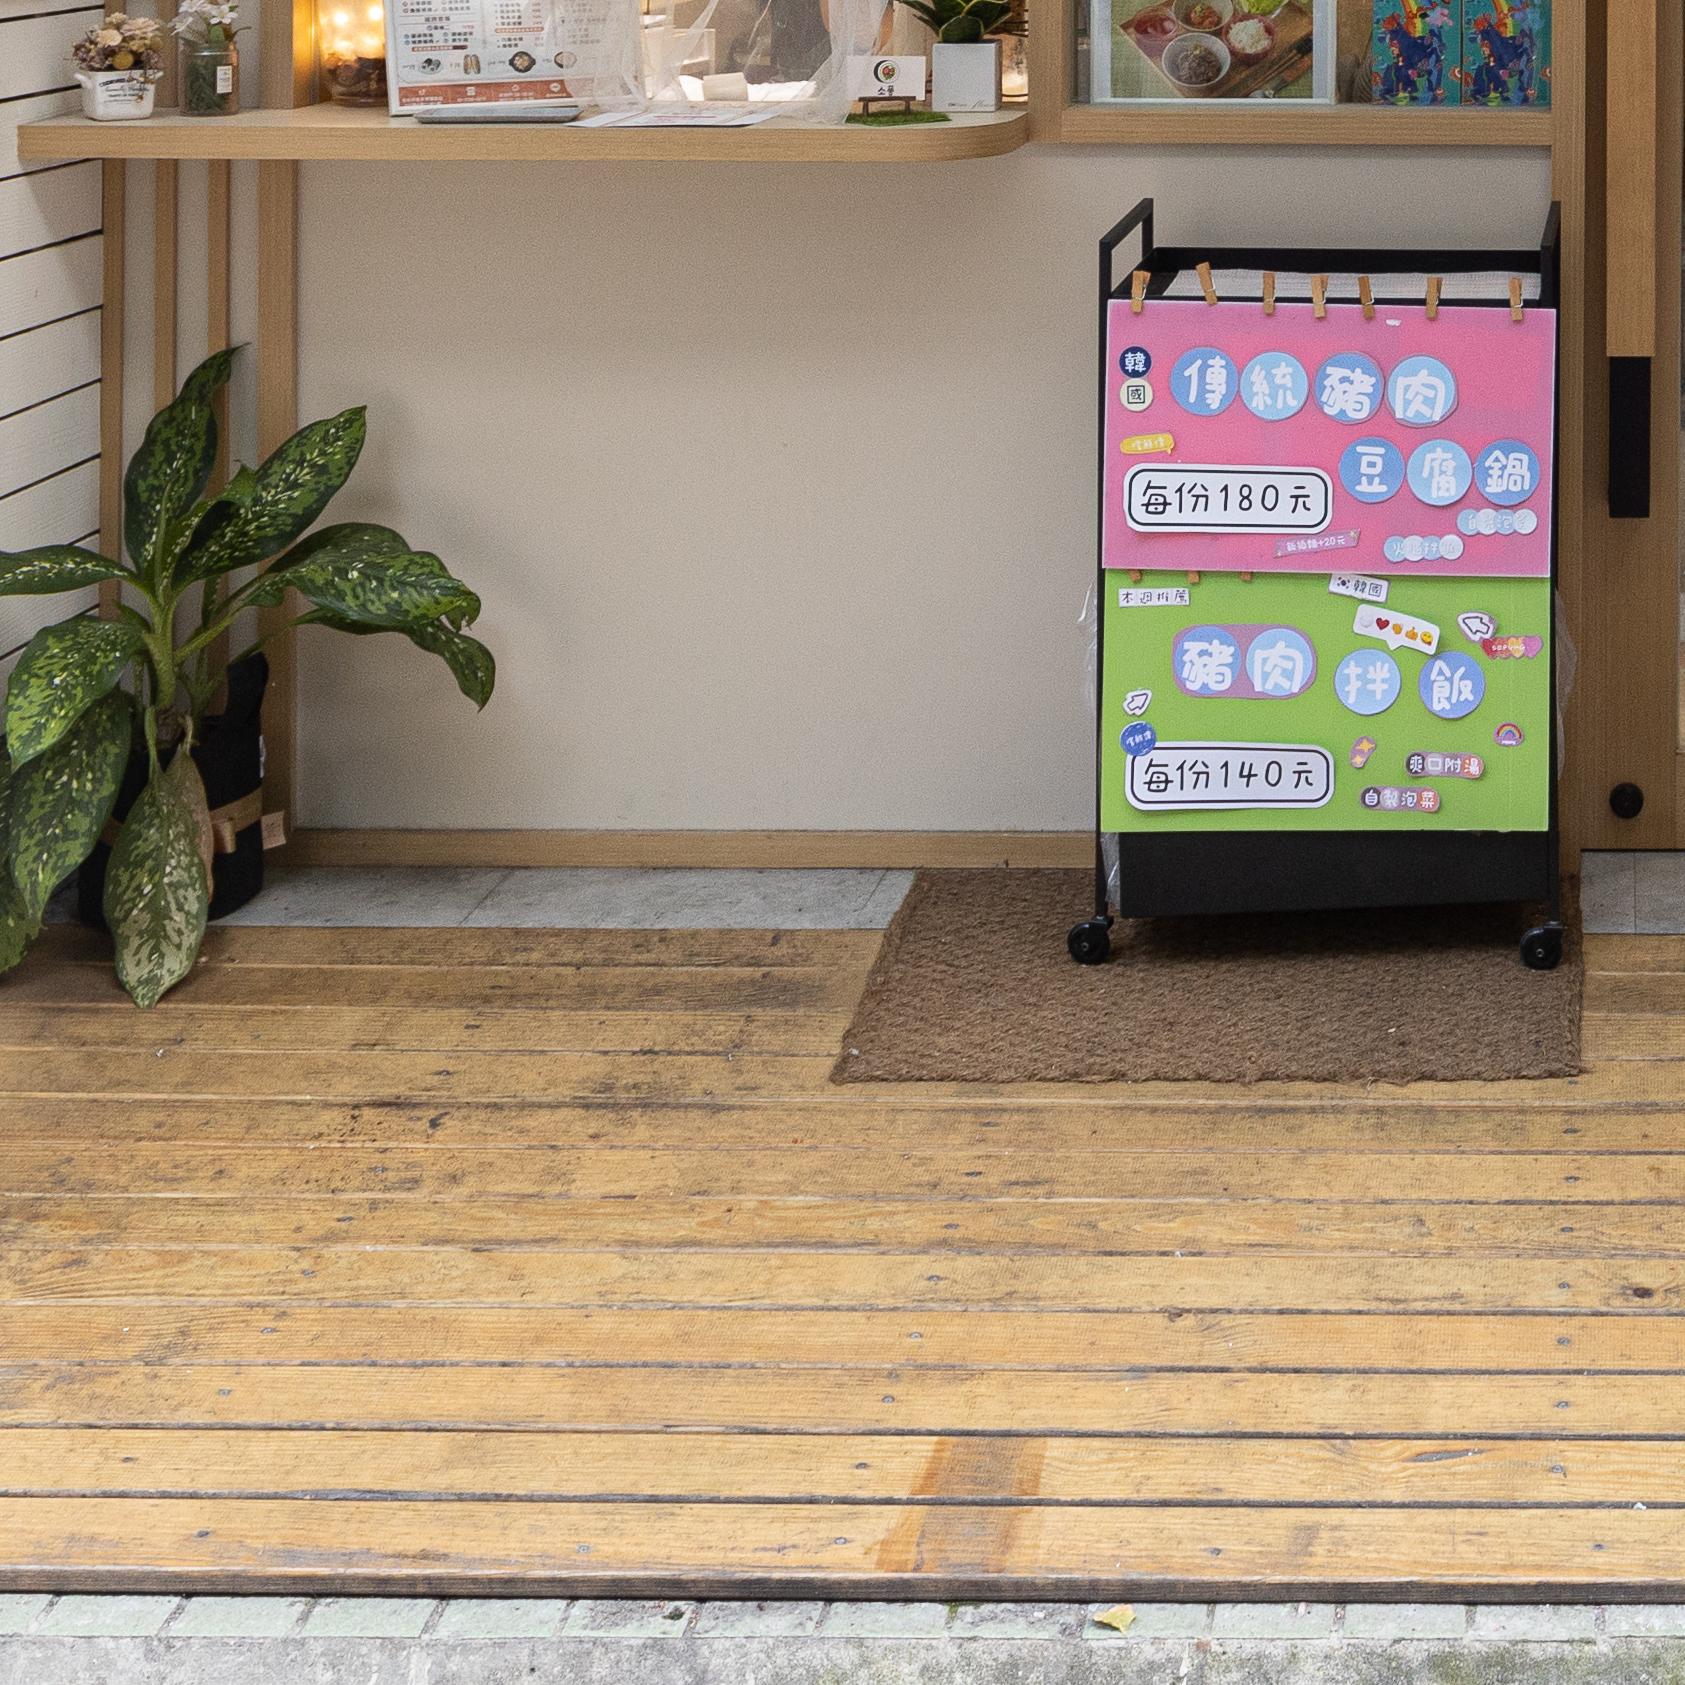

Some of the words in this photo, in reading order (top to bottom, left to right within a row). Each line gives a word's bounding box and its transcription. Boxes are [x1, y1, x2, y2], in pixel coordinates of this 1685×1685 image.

[1125, 352, 1147, 404] 韓國
[1184, 356, 1445, 421] 傳統豬肉
[1355, 445, 1531, 498] 豆腐鍋
[1141, 480, 1310, 515] 每份180元
[1121, 589, 1188, 605] 本週推薦
[1352, 579, 1382, 599] 韓國
[1182, 640, 1474, 710] 豬肉拌飯
[1143, 759, 1313, 792] 每份140元
[1410, 756, 1479, 775] 爽口附湯
